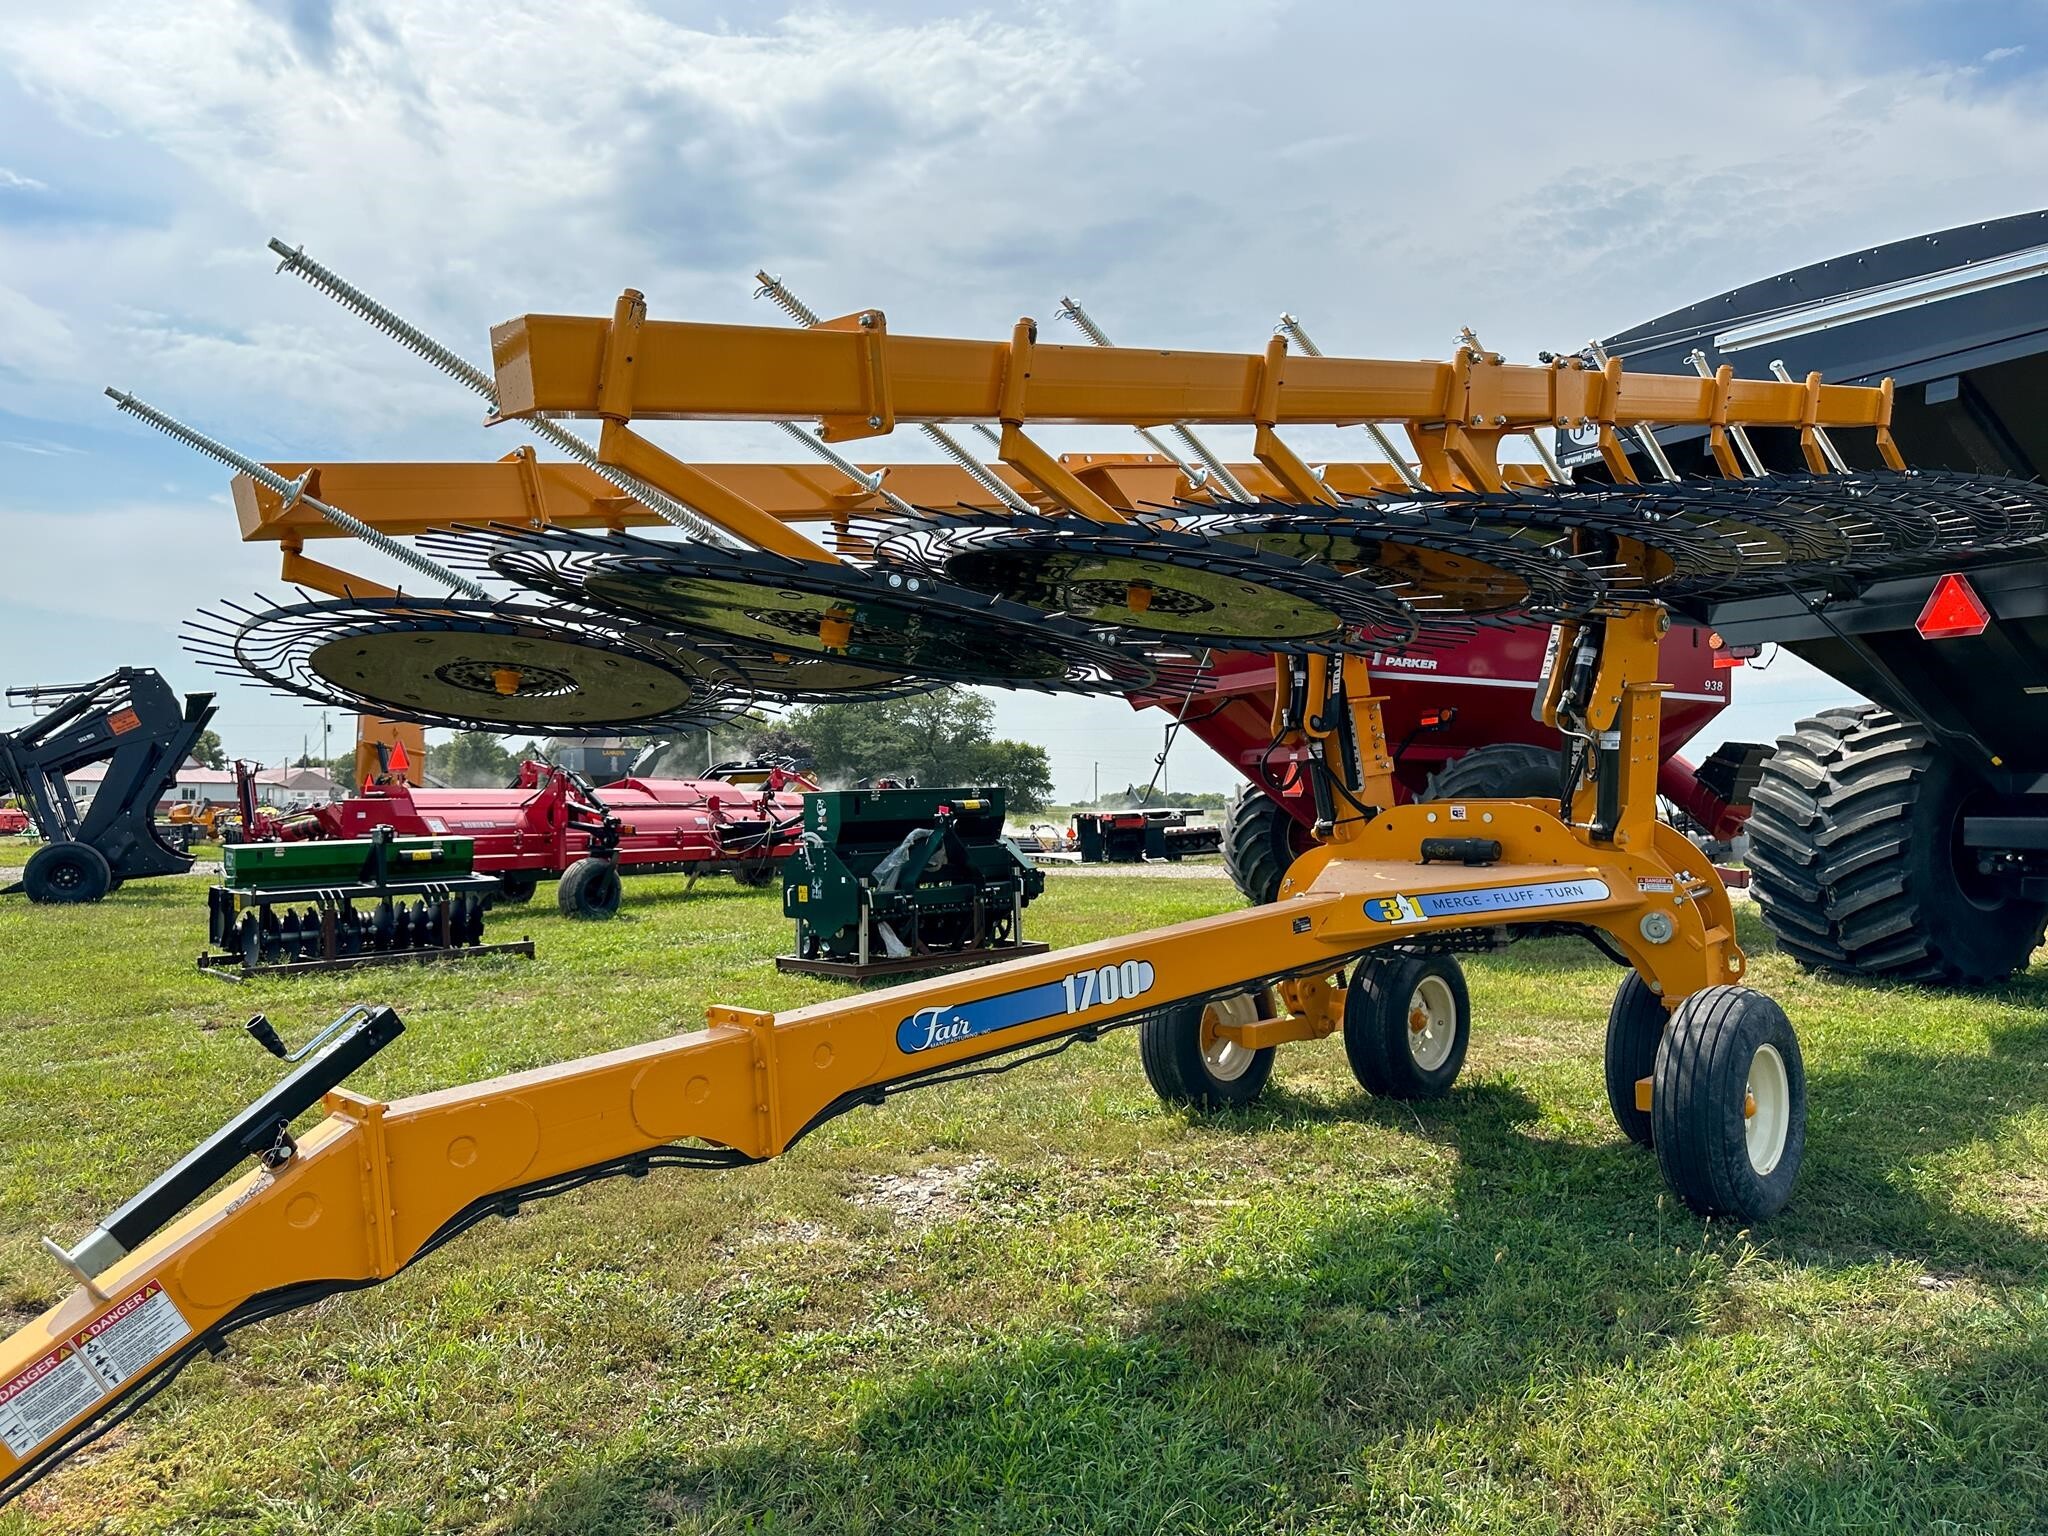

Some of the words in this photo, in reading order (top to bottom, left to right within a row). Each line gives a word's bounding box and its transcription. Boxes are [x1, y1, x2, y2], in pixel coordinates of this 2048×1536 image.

[1385, 656, 1438, 670] PARKER
[1704, 679, 1724, 692] 938
[1379, 899, 1403, 920] 3
[1407, 896, 1425, 918] 1
[1433, 892, 1483, 910] MERGE
[1494, 889, 1534, 905] FLUFF
[1547, 885, 1585, 899] TURN
[1062, 959, 1141, 1015] 1700
[910, 1004, 972, 1051] Fair
[90, 1293, 146, 1336] DANGER
[0, 1356, 57, 1402] DANGER
